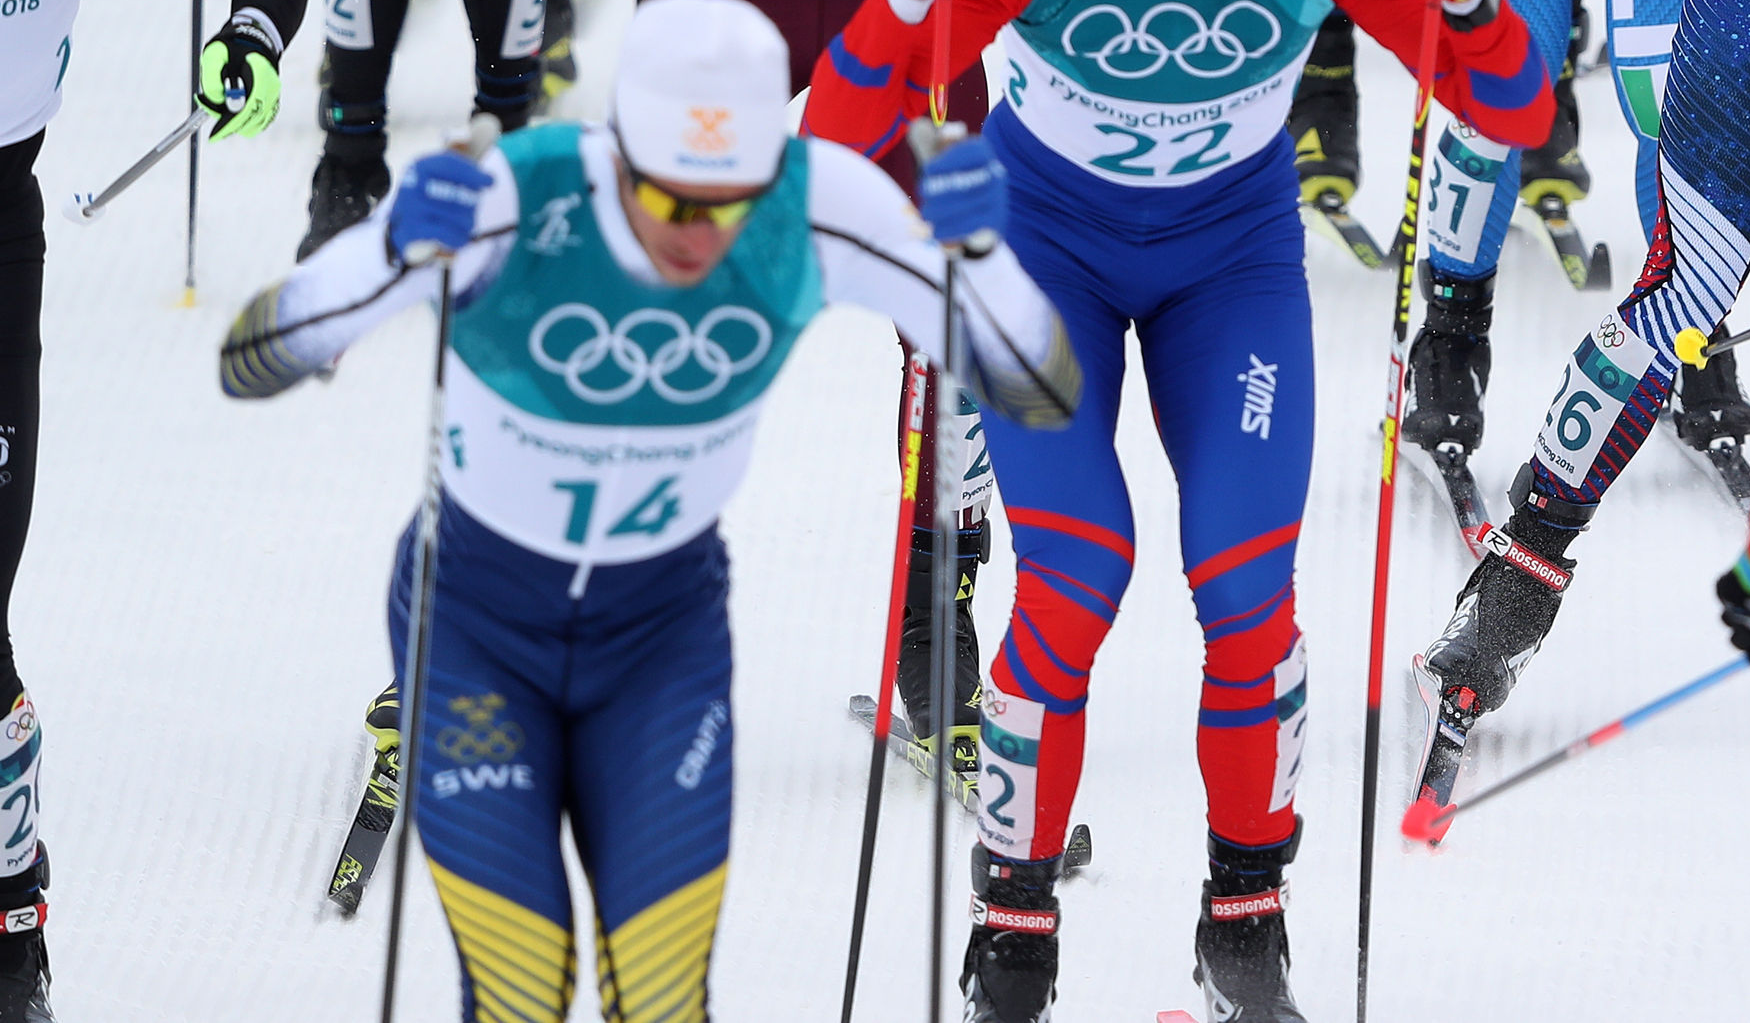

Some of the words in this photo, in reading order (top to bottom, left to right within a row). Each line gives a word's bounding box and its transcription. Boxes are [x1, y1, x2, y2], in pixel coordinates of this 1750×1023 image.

[1050, 74, 1223, 128] PyeongChang
[1088, 121, 1234, 177] 22
[1401, 151, 1423, 238] LEKI
[1427, 155, 1471, 235] 31
[552, 474, 680, 546] 14
[433, 763, 535, 798] SWE
[2, 788, 40, 850] 2
